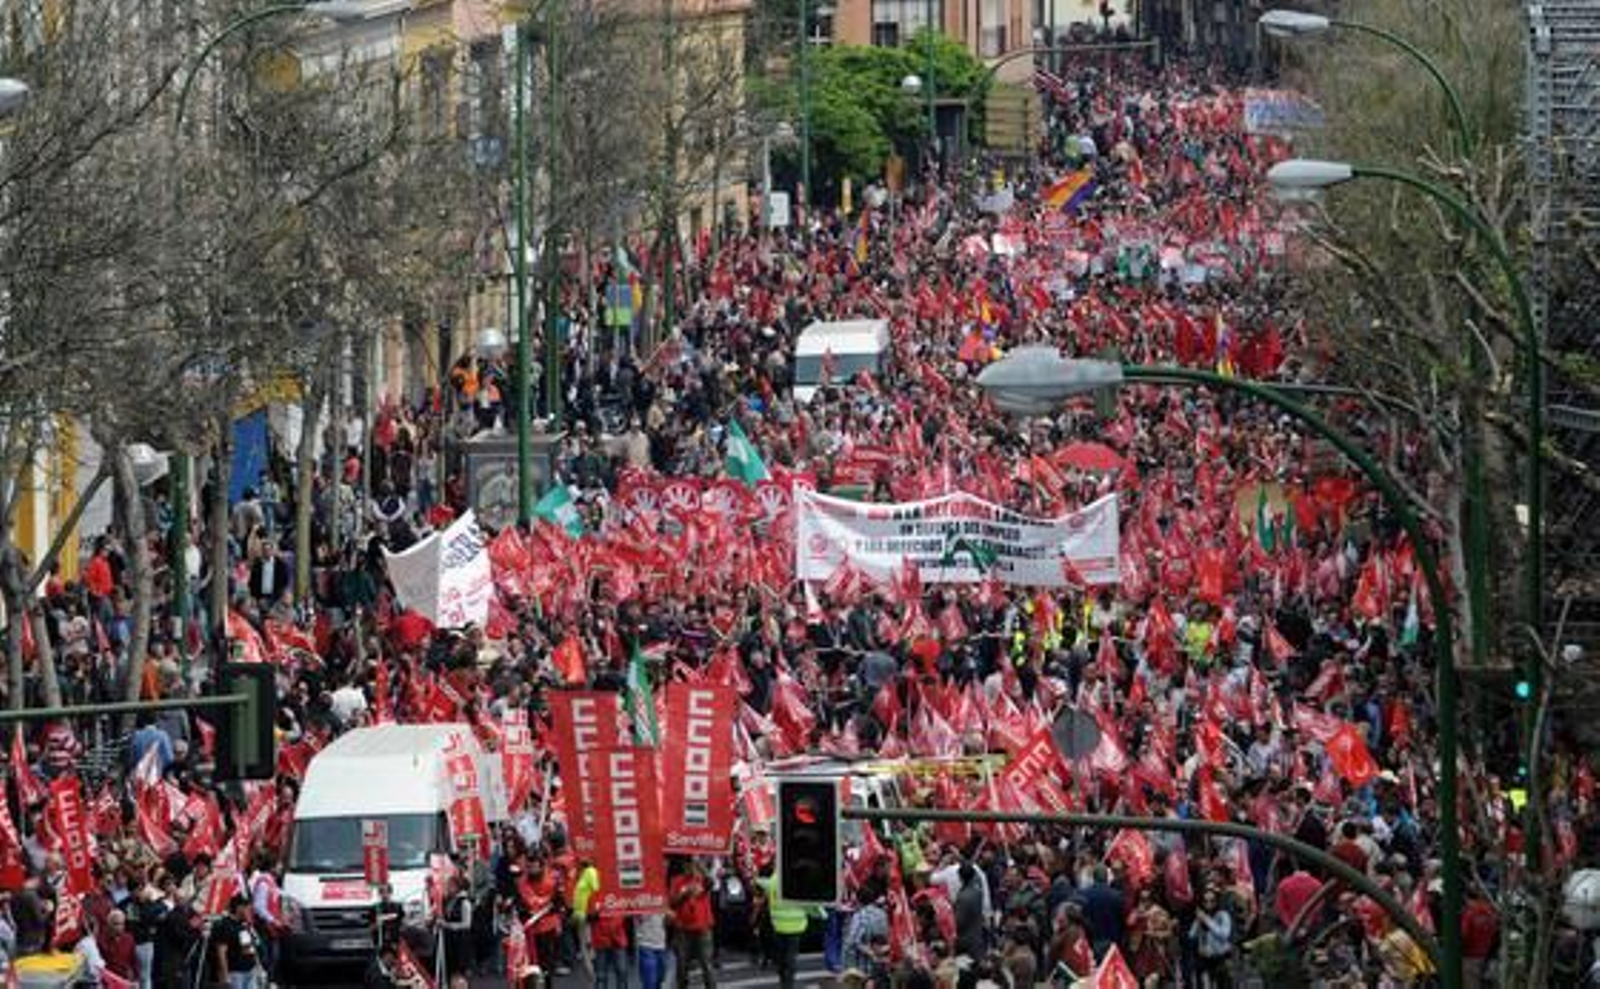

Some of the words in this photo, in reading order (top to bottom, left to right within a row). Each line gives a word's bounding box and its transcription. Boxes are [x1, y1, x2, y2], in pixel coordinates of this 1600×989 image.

[685, 690, 715, 799] CCOO
[610, 753, 644, 860] CCOO
[666, 832, 726, 848] Sevilla
[604, 893, 665, 911] Sevilla
